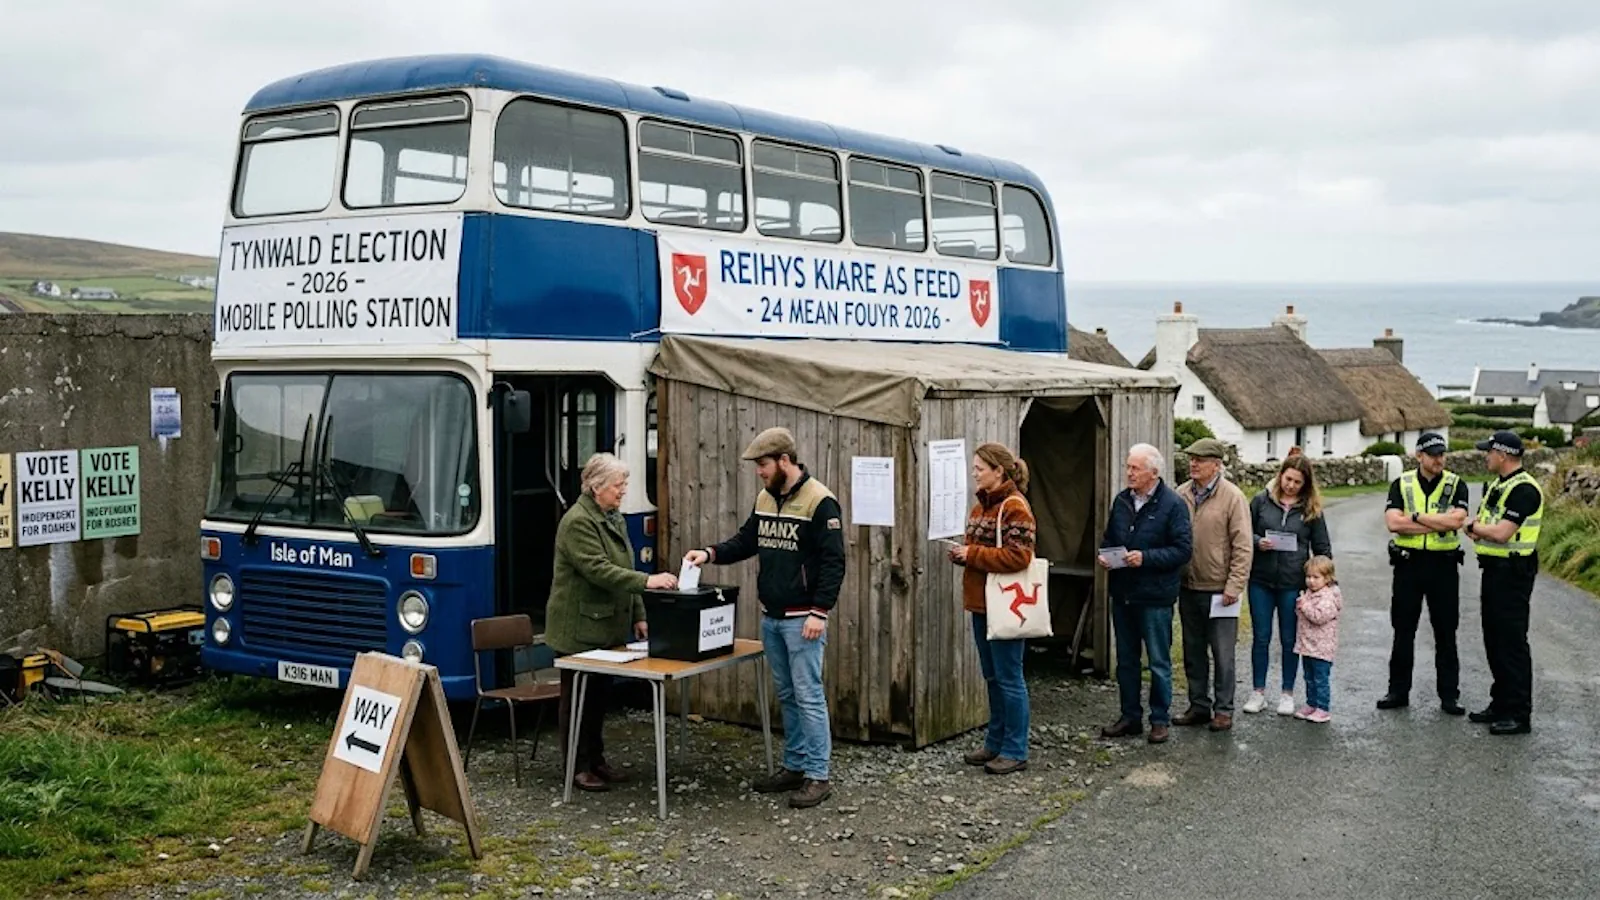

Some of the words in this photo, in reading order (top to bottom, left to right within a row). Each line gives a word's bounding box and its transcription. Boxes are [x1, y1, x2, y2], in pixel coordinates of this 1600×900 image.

[230, 235, 321, 271] TYNWALD
[331, 228, 447, 264] ELECTION
[302, 271, 348, 294] 2026
[720, 250, 806, 288] REIHYS
[814, 258, 877, 293] KIARE
[883, 265, 908, 296] AS
[914, 268, 960, 299] FEED
[220, 302, 276, 331] MOBILE
[283, 299, 358, 330] POLLING
[366, 296, 451, 328] STATION
[760, 297, 783, 322] 24
[789, 300, 838, 325] MEAN
[845, 302, 899, 328] FOUYR
[904, 306, 941, 329] 2026
[26, 455, 69, 476] VOTE
[90, 452, 130, 472] VOTE
[21, 478, 75, 503] KELLY
[86, 474, 136, 498] KELLY
[22, 525, 39, 536] FOR
[86, 519, 103, 530] FOR
[758, 520, 800, 541] MANX
[271, 542, 297, 563] Isle
[300, 545, 317, 564] of
[319, 547, 353, 568] Man
[354, 697, 392, 730] WAY
